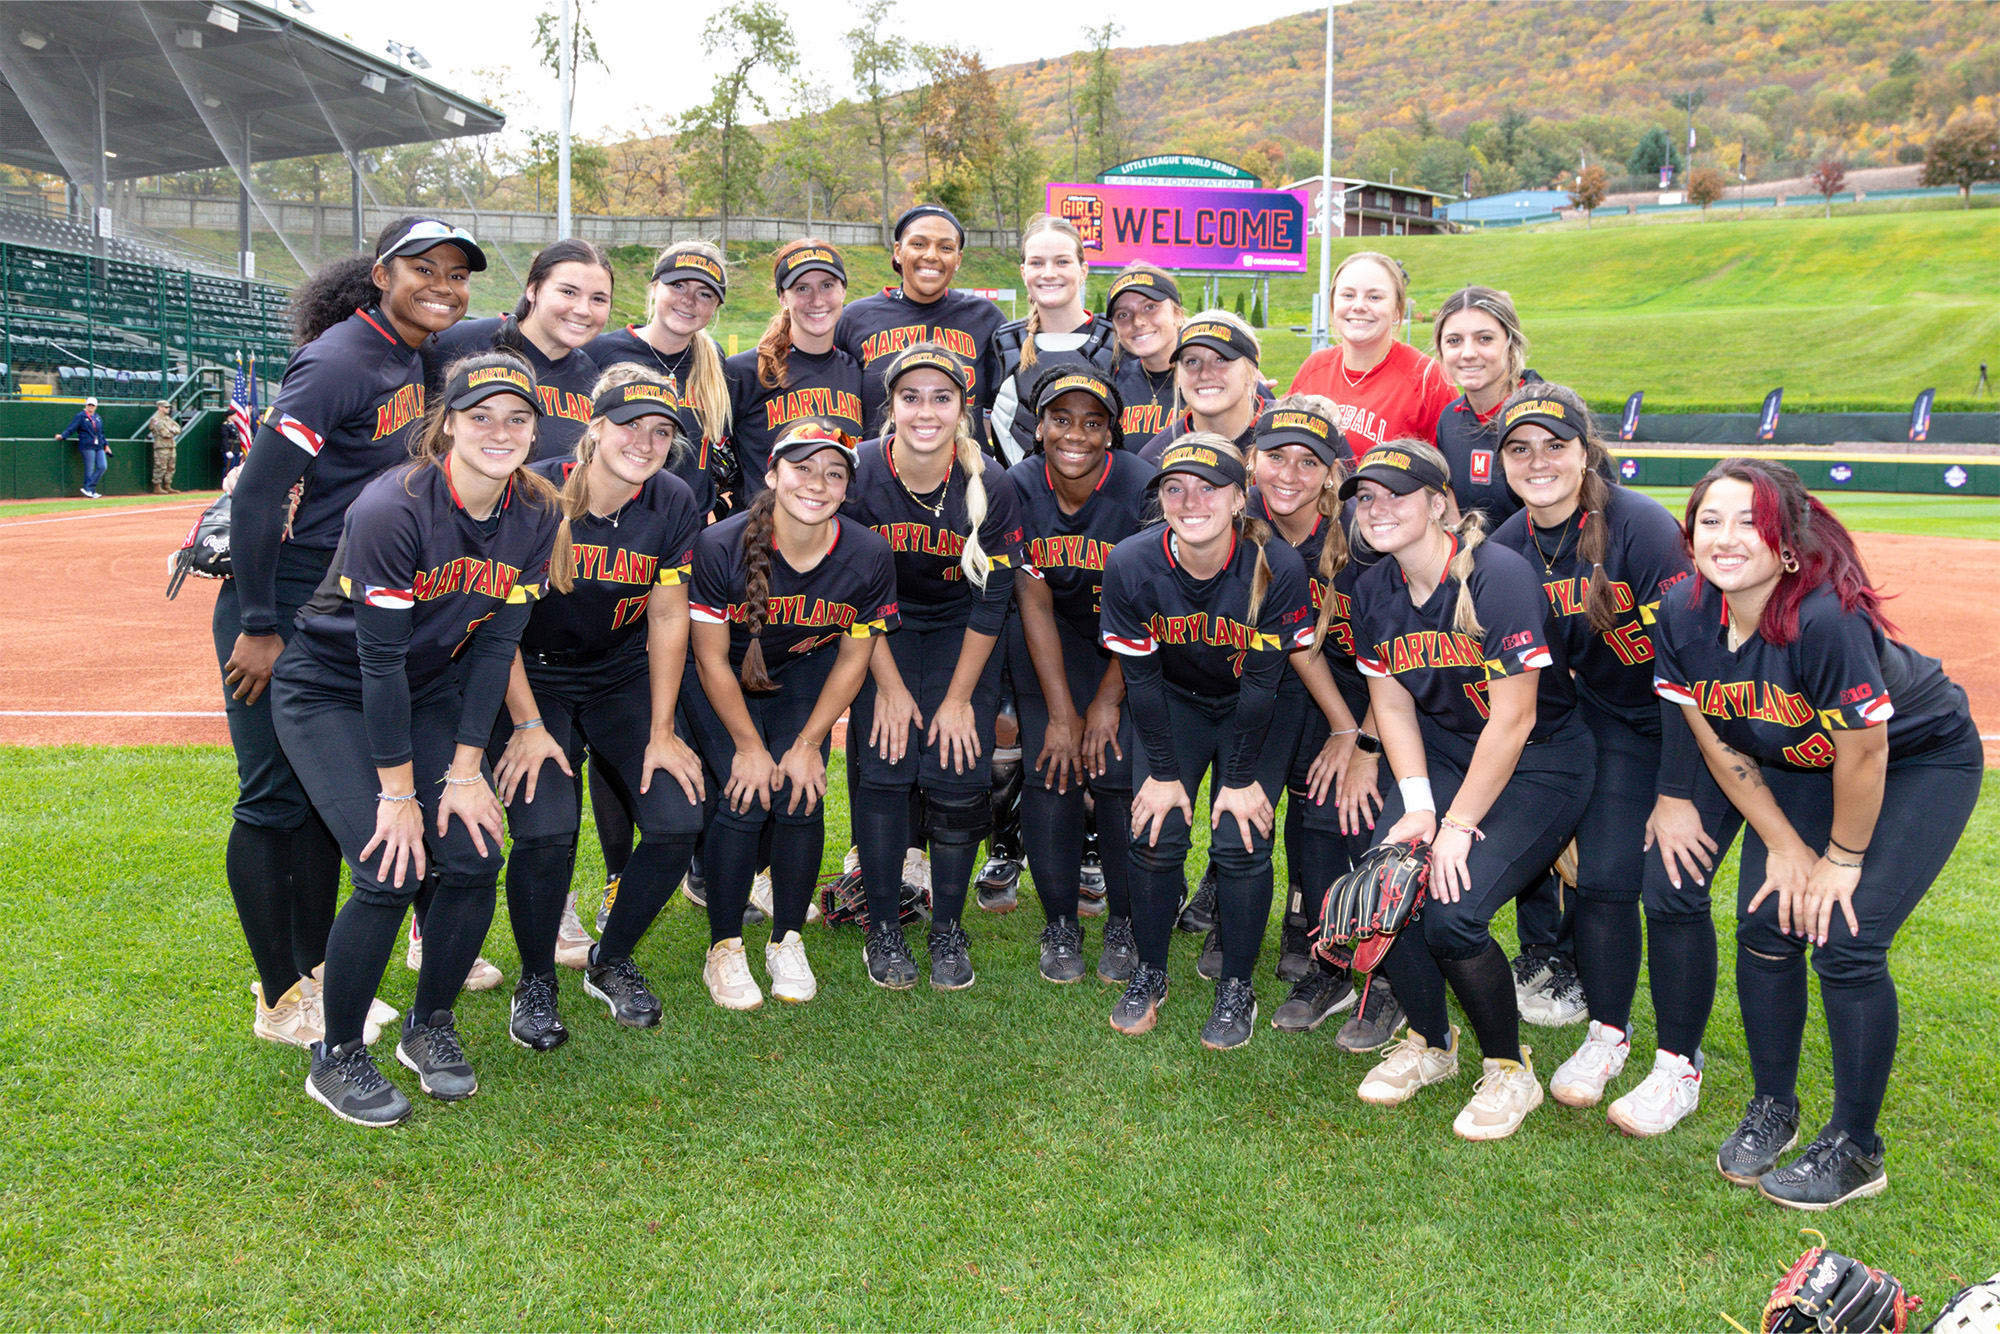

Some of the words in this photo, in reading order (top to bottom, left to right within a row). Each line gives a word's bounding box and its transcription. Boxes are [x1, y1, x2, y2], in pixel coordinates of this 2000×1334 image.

[1121, 159, 1148, 174] LITTLE
[1148, 155, 1180, 167] LEAGUE
[1182, 156, 1211, 168] WORLD
[1211, 161, 1239, 177] SERIES
[1107, 176, 1158, 185] EASTON
[1161, 178, 1251, 188] FOUNDATIONS
[1062, 200, 1102, 217] GIRLS
[1111, 206, 1293, 251] WELCOME
[675, 254, 721, 282] MARYLAND
[787, 249, 834, 270] MARYLAND
[1181, 323, 1232, 343] MARYLAND
[862, 324, 976, 369] MARYLAND
[468, 367, 532, 393] MARYLAND
[1054, 374, 1108, 398] MARYLAND
[623, 384, 678, 412] MARYLAND
[1272, 413, 1328, 439] MARYLAND
[1505, 400, 1565, 426] MARYLAND
[1162, 446, 1217, 469] MARYLAND
[1473, 455, 1486, 473] M
[611, 590, 650, 630] 17
[1602, 619, 1656, 666] 16
[1782, 732, 1838, 768] 18
